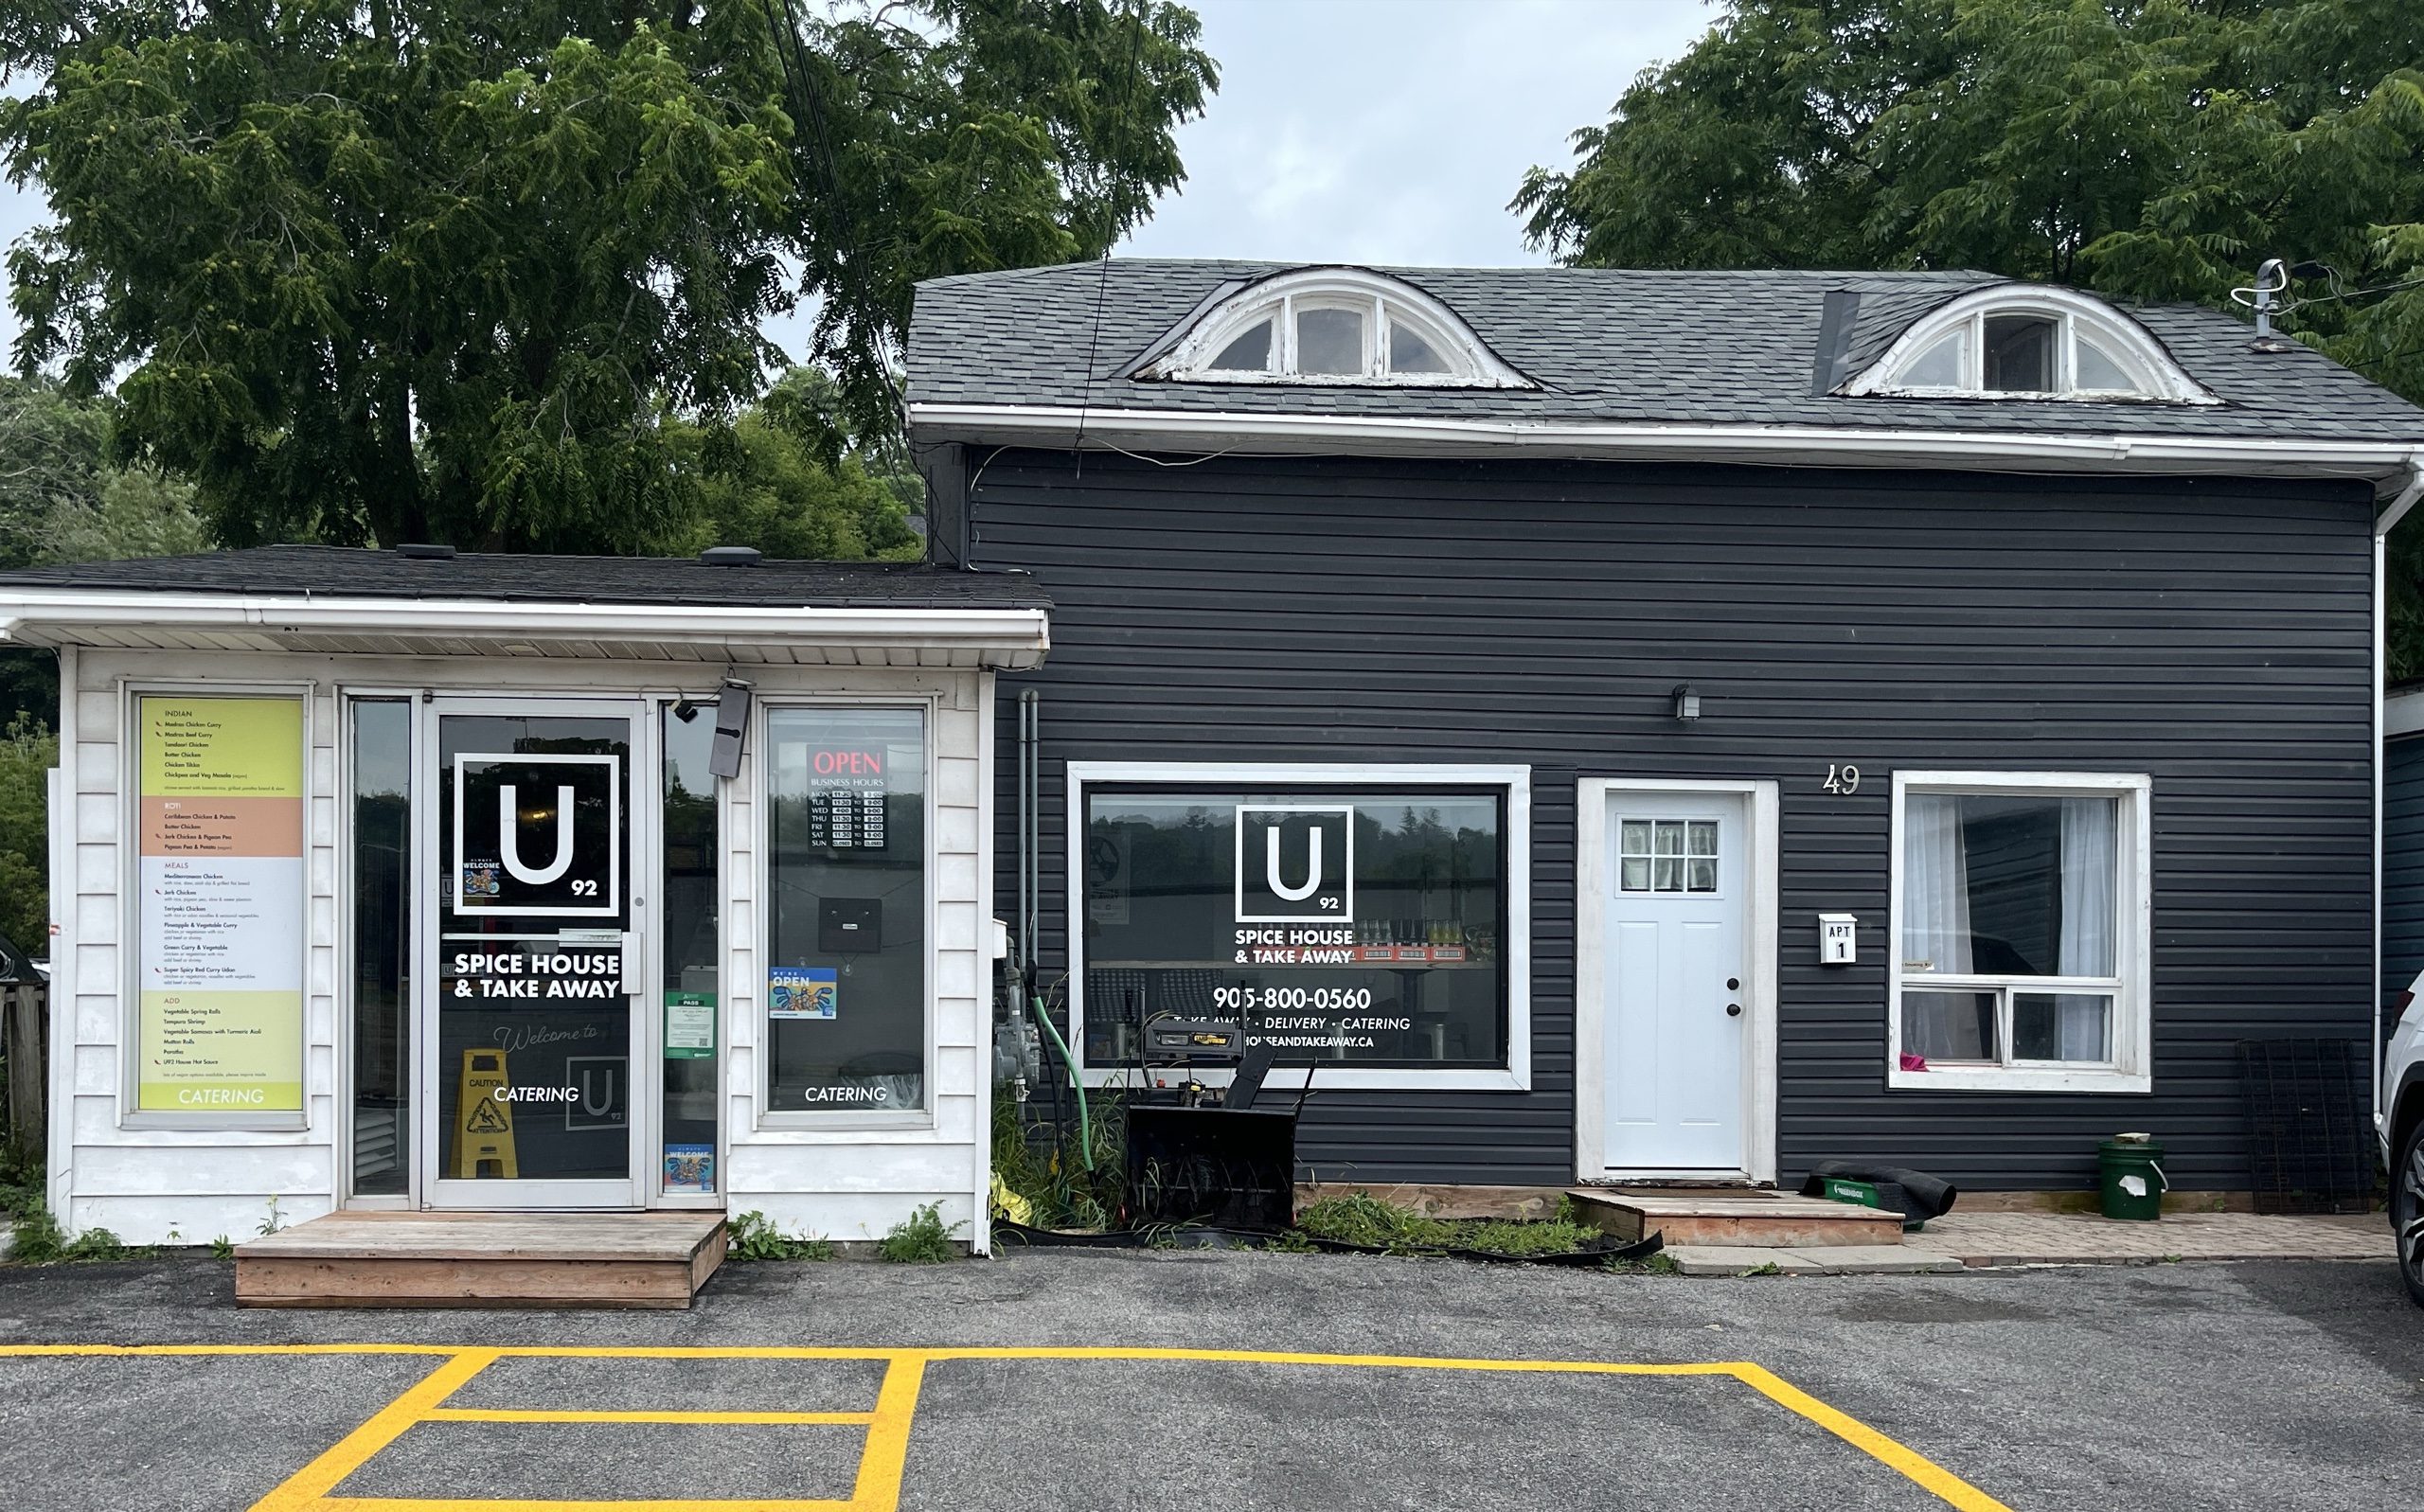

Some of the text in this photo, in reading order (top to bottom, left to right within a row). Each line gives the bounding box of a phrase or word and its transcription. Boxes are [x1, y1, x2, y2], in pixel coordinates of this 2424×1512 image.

[813, 752, 881, 774] OPEN
[853, 778, 883, 787] HOURS
[1823, 764, 1860, 794] 49
[500, 785, 574, 884] U
[1267, 826, 1322, 900] U
[571, 880, 597, 896] 92
[1319, 898, 1338, 909] 92
[1235, 930, 1353, 945] SPICE HOUSE
[1829, 926, 1850, 937] APT
[1235, 950, 1249, 964] &
[1253, 950, 1295, 964] TAKE
[1300, 950, 1353, 964] AWAY
[1838, 943, 1845, 958] 1
[454, 953, 619, 975] SPICE HOUSE
[454, 978, 619, 999] & TAKE AWAY
[773, 976, 810, 987] OPEN
[1213, 987, 1371, 1009] 905-800-0560
[1265, 1017, 1327, 1029] DELIVERY
[1342, 1018, 1411, 1030] CATERING
[493, 1023, 597, 1053] Welcome to
[469, 1079, 504, 1088] CAUTION
[179, 1089, 264, 1104] CATERING
[493, 1086, 579, 1102] CATERING
[583, 1070, 613, 1116] U
[805, 1087, 887, 1102] CATERING
[611, 1112, 621, 1121] 92
